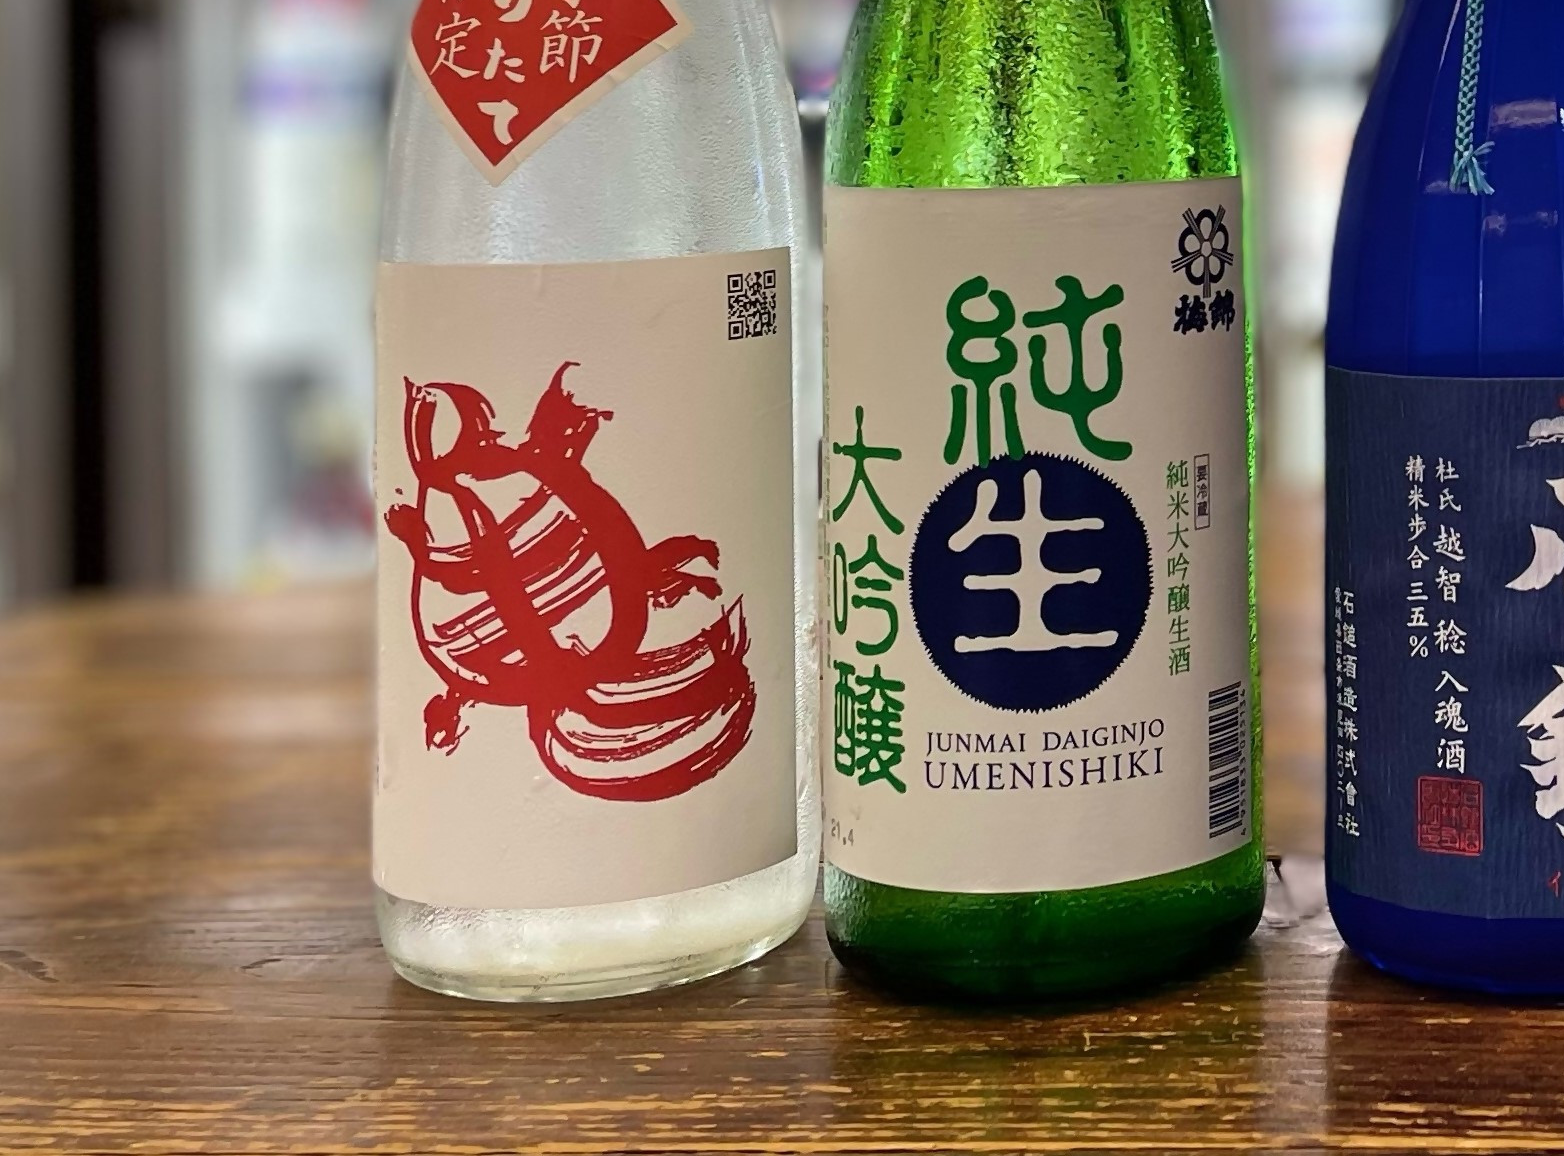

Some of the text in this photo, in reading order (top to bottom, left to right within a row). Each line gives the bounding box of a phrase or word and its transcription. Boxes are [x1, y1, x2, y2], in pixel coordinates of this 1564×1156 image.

[833, 405, 906, 794] 大吟醸
[1165, 459, 1191, 676] 純米大吟醸生酒
[923, 746, 1165, 791] UMENISHIKI
[925, 717, 1165, 757] JUNMAI DAIGINJO
